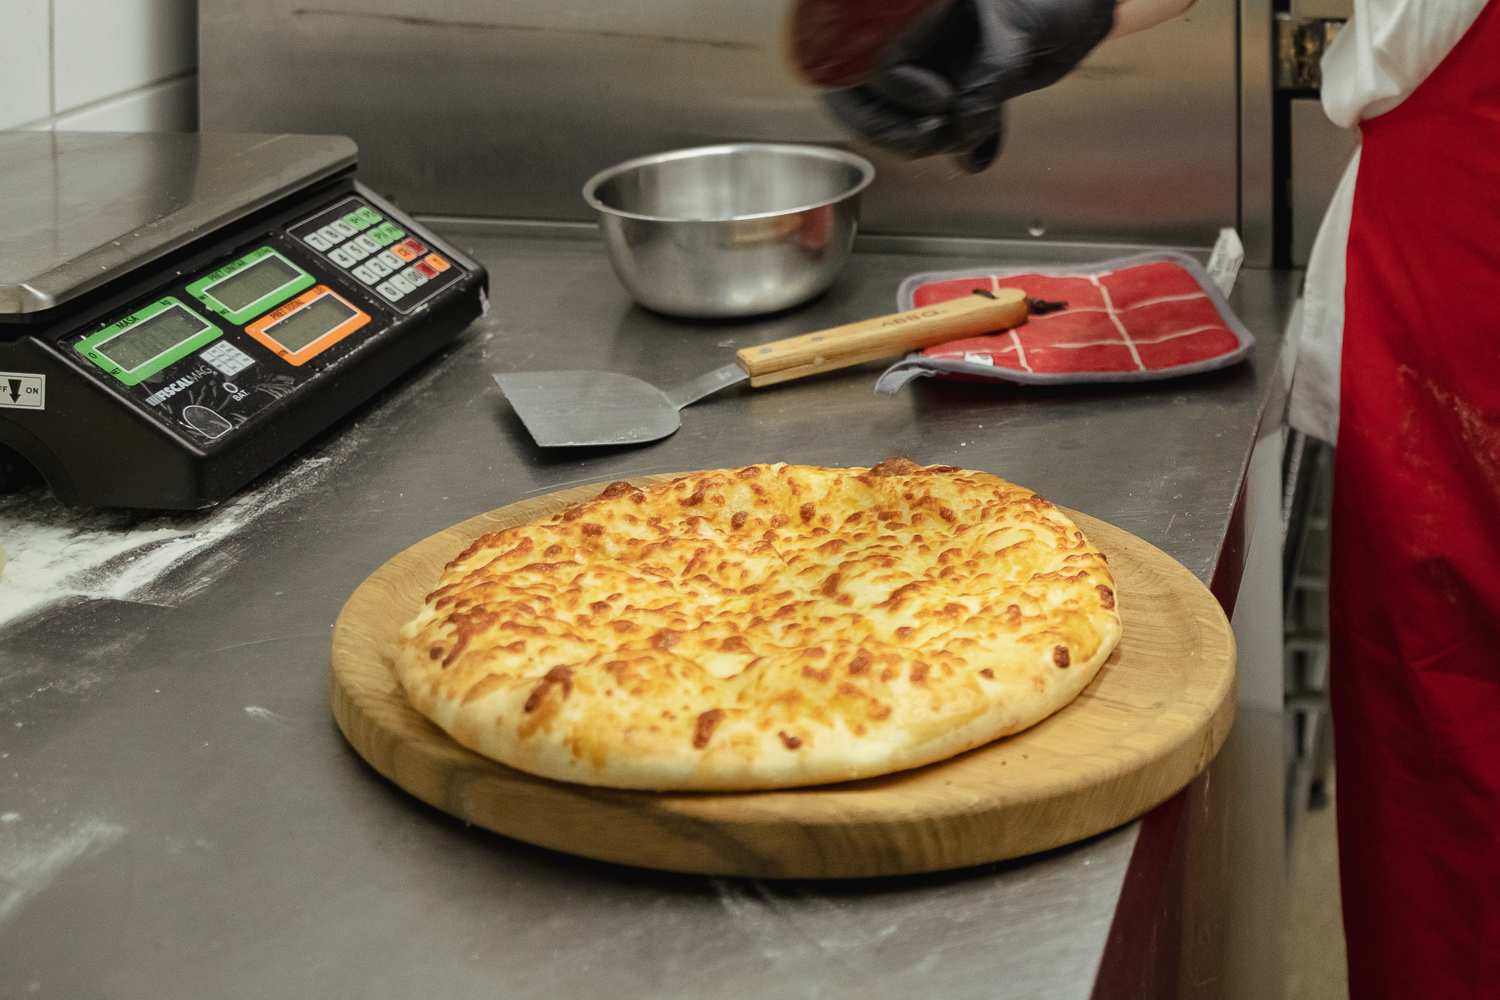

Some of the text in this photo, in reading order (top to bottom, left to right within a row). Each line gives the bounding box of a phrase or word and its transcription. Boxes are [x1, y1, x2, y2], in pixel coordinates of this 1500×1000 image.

[116, 315, 139, 329] MASA
[25, 386, 39, 394] ON
[155, 365, 213, 401] FISCALMAG
